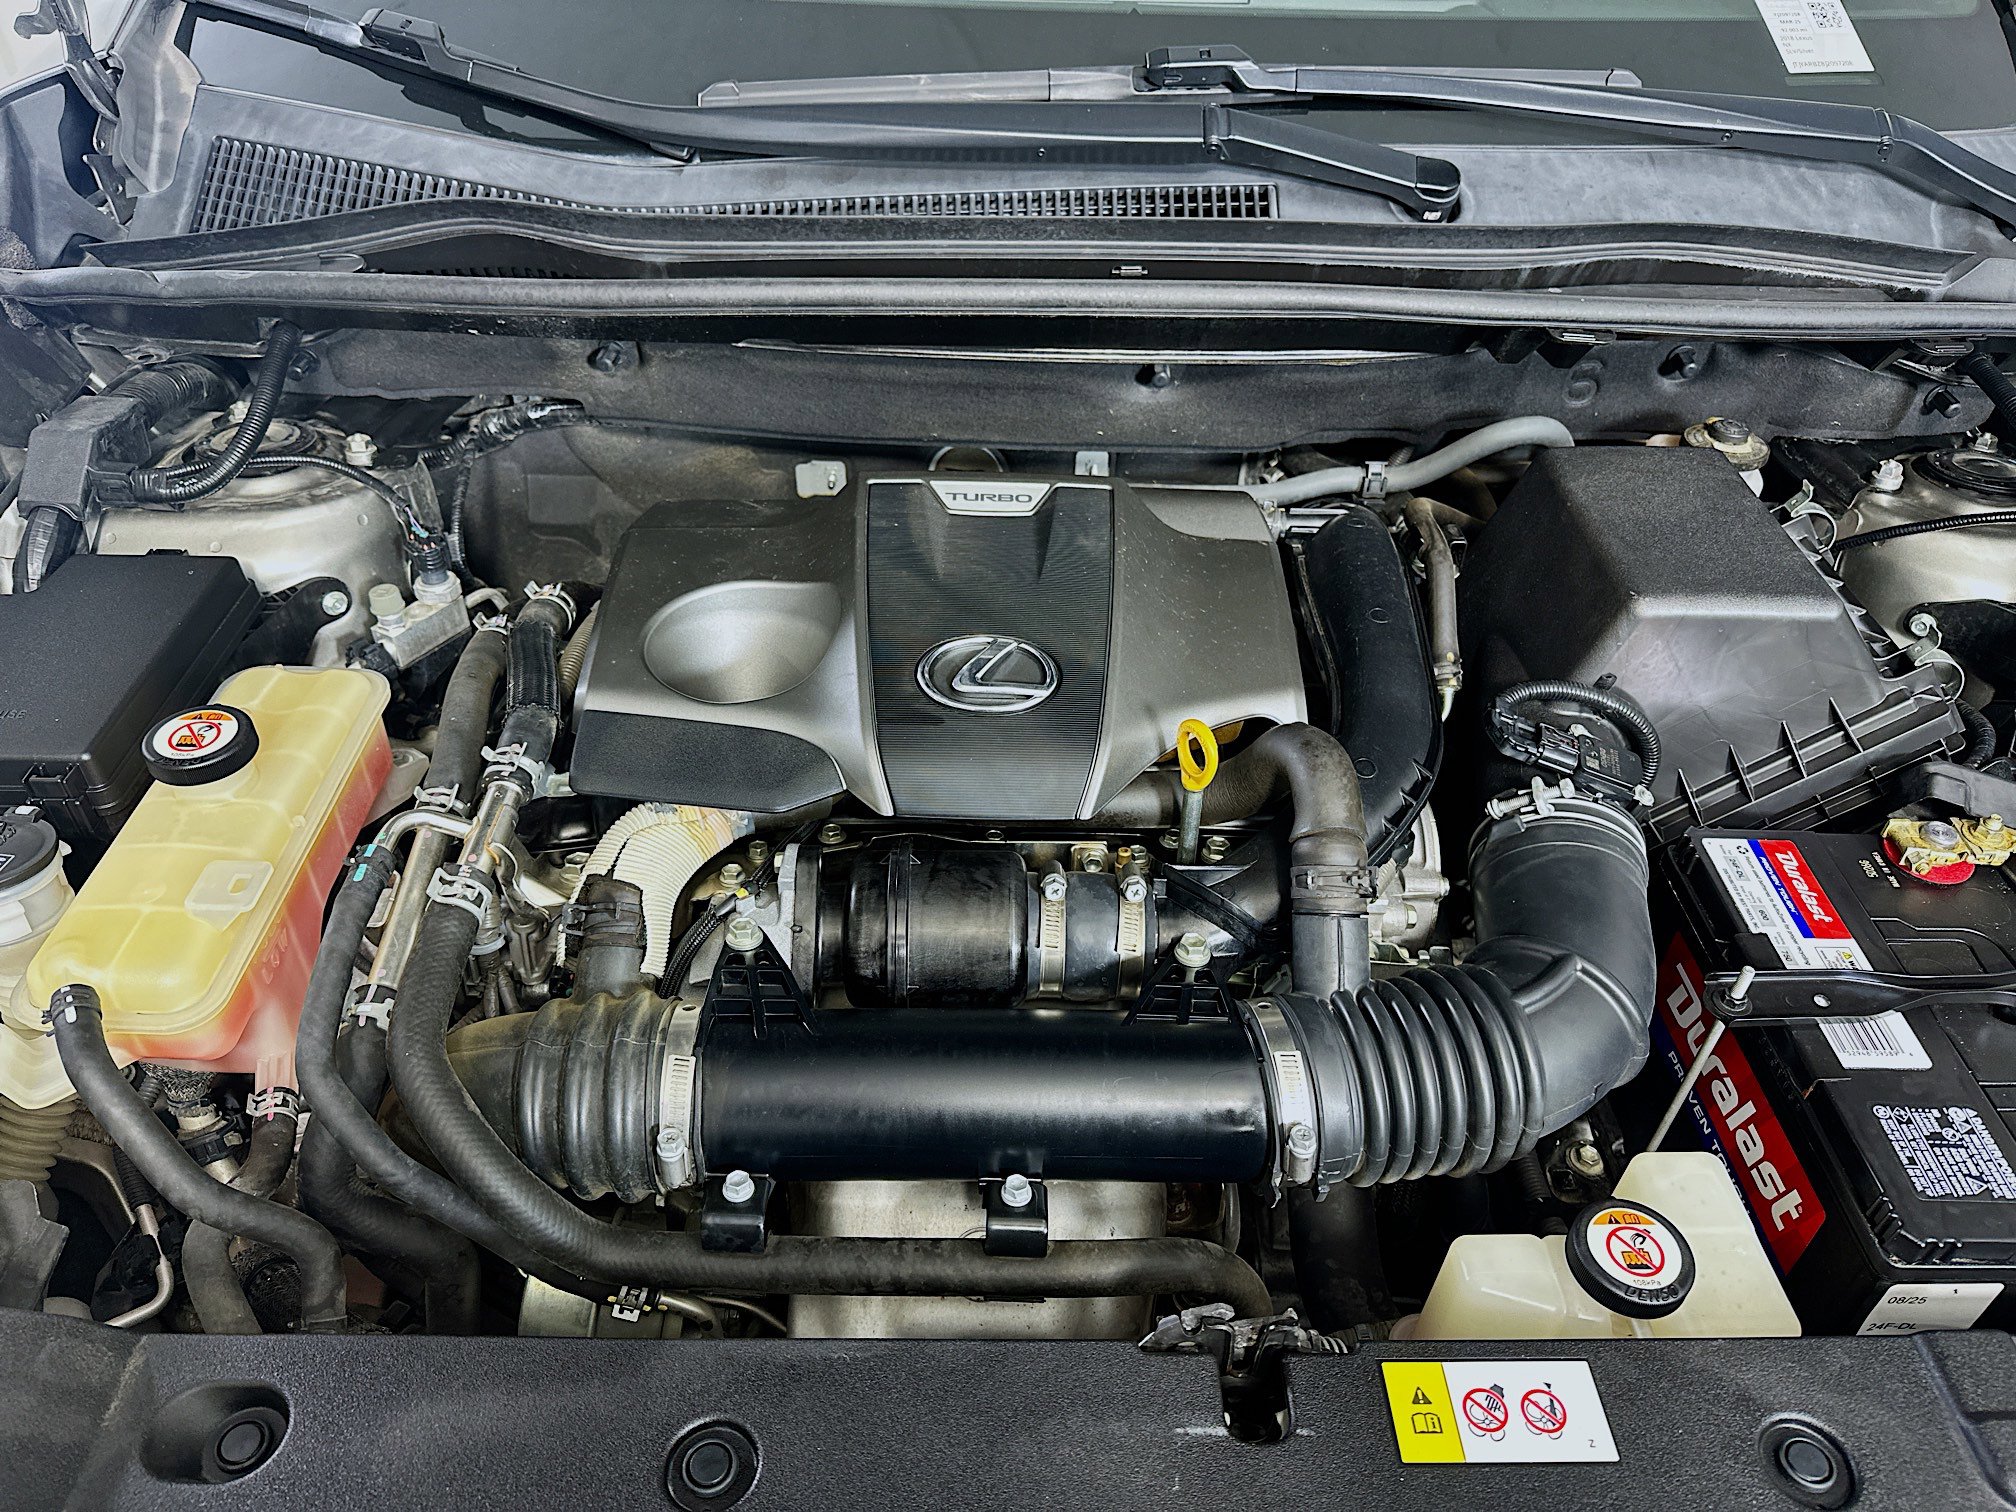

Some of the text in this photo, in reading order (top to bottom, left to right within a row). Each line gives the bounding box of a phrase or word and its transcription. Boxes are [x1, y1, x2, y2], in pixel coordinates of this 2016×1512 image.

[945, 492, 1033, 503] TURBO
[1759, 856, 1797, 914] PROVEN TOUGH
[1775, 850, 1834, 923] Duralast
[1758, 909, 1769, 921] 600
[1781, 950, 1793, 962] 750
[1667, 963, 1803, 1232] Duralast
[1668, 1051, 1711, 1135] PRVEN
[1625, 1285, 1680, 1302] DENSO
[1888, 1296, 1928, 1304] 08/25
[1866, 1323, 1918, 1332] 24F-DL
